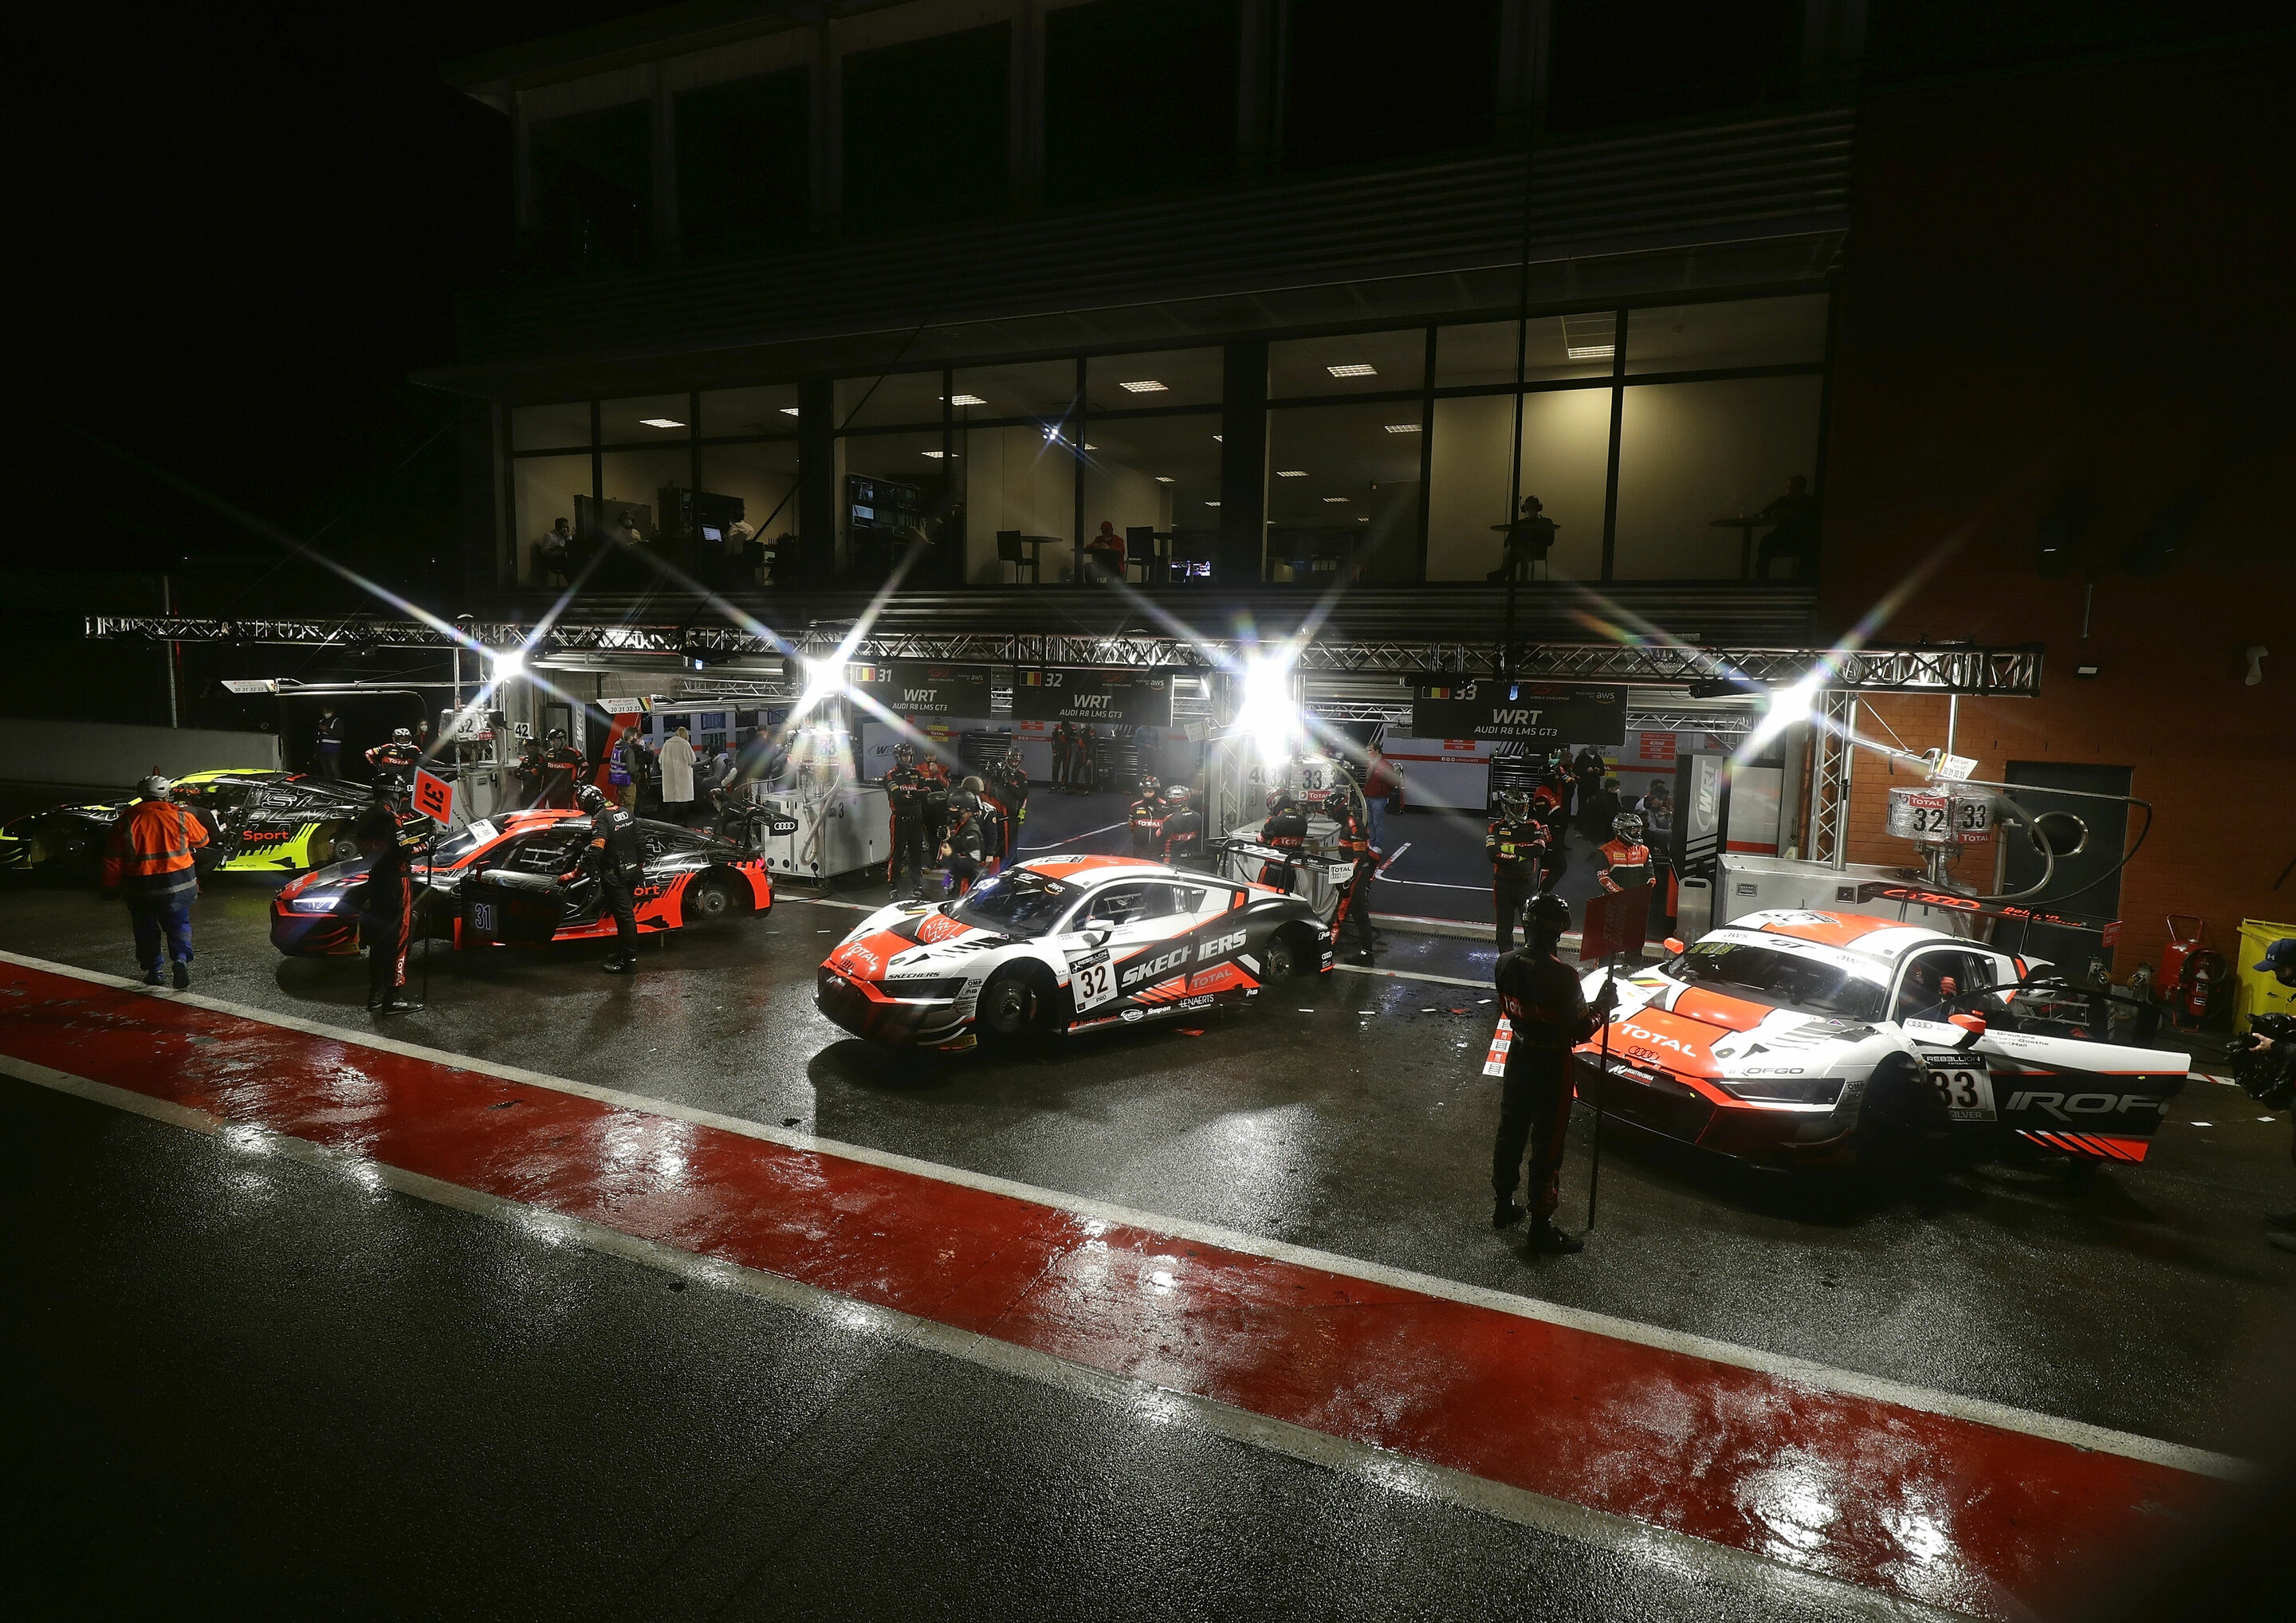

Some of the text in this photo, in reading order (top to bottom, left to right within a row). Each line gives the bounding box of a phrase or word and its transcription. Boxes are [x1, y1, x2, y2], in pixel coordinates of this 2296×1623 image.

[878, 670, 892, 682] 31
[1045, 673, 1063, 687] 32
[904, 689, 938, 701] WRT
[1454, 685, 1478, 701] 33
[1596, 690, 1615, 699] aws
[1073, 694, 1111, 709] WRT
[1492, 709, 1543, 725] WRT
[515, 724, 529, 737] 42
[1516, 727, 1536, 736] LMS
[1539, 728, 1558, 737] GT3
[1302, 769, 1323, 790] 33
[1953, 769, 1959, 778] 32
[1959, 771, 1965, 780] 33
[1699, 759, 1715, 813] WRT
[423, 782, 443, 813] 31
[1911, 797, 1943, 807] TOTAL
[1913, 808, 1944, 833] 32
[1963, 804, 1987, 829] 33
[242, 831, 289, 842] Sport
[1047, 882, 1066, 894] aws
[474, 903, 492, 930] 31
[848, 942, 879, 965] TOTAL
[396, 957, 405, 986] TOTAL
[1191, 969, 1233, 988] TOTAL
[1080, 965, 1108, 998] 32
[1179, 994, 1214, 1008] LENAERTS
[1097, 1015, 1117, 1025] Sport
[1622, 1023, 1696, 1058] TOTAL
[1929, 1071, 1978, 1108] 33
[1948, 1110, 1983, 1119] SILVER
